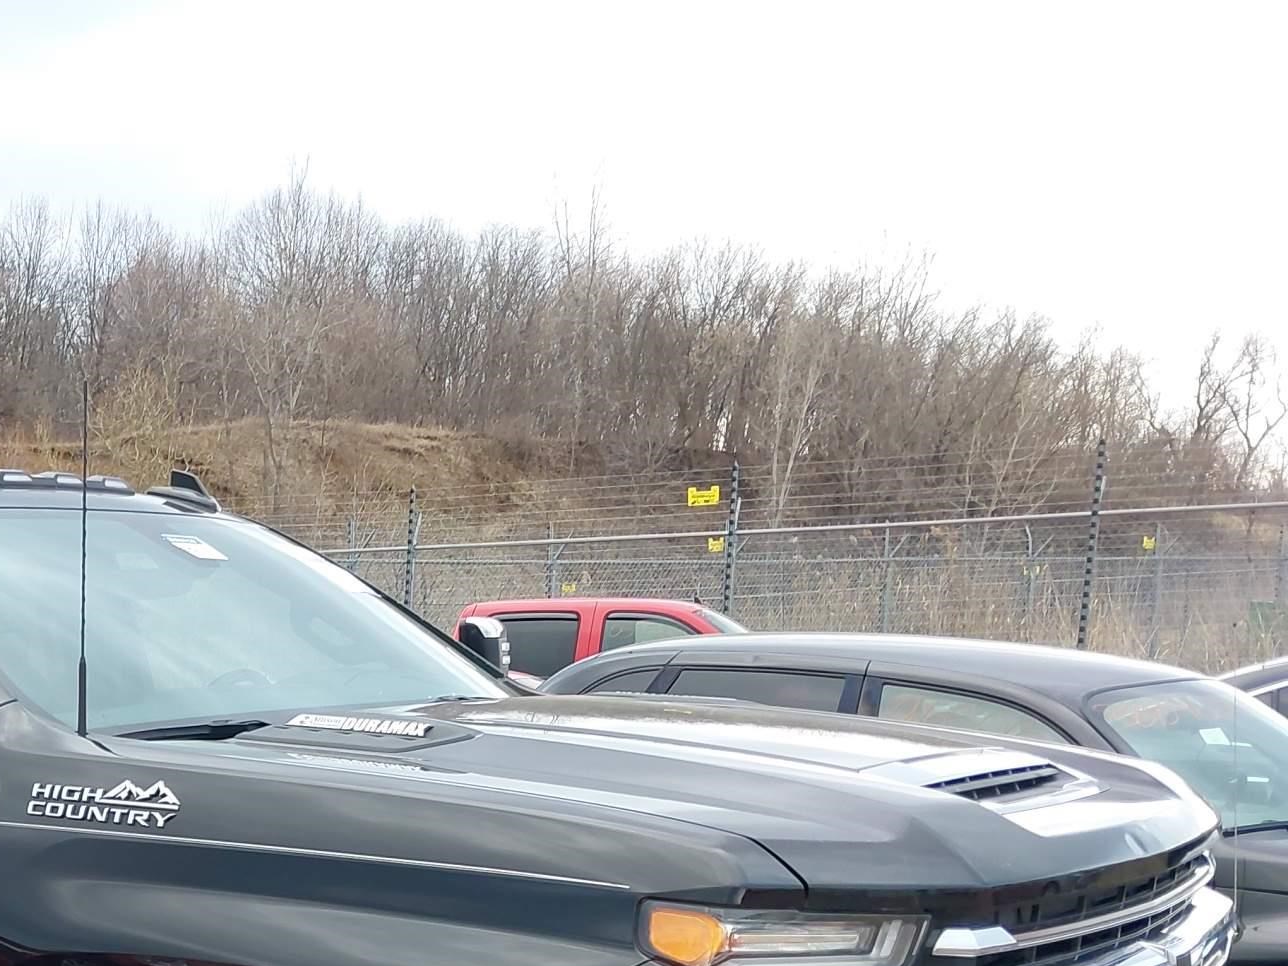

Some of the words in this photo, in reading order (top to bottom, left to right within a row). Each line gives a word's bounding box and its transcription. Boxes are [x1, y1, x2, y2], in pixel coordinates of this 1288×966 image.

[341, 717, 432, 738] DURAMAX
[31, 782, 105, 803] HIGH
[26, 800, 177, 828] COUNTRY
